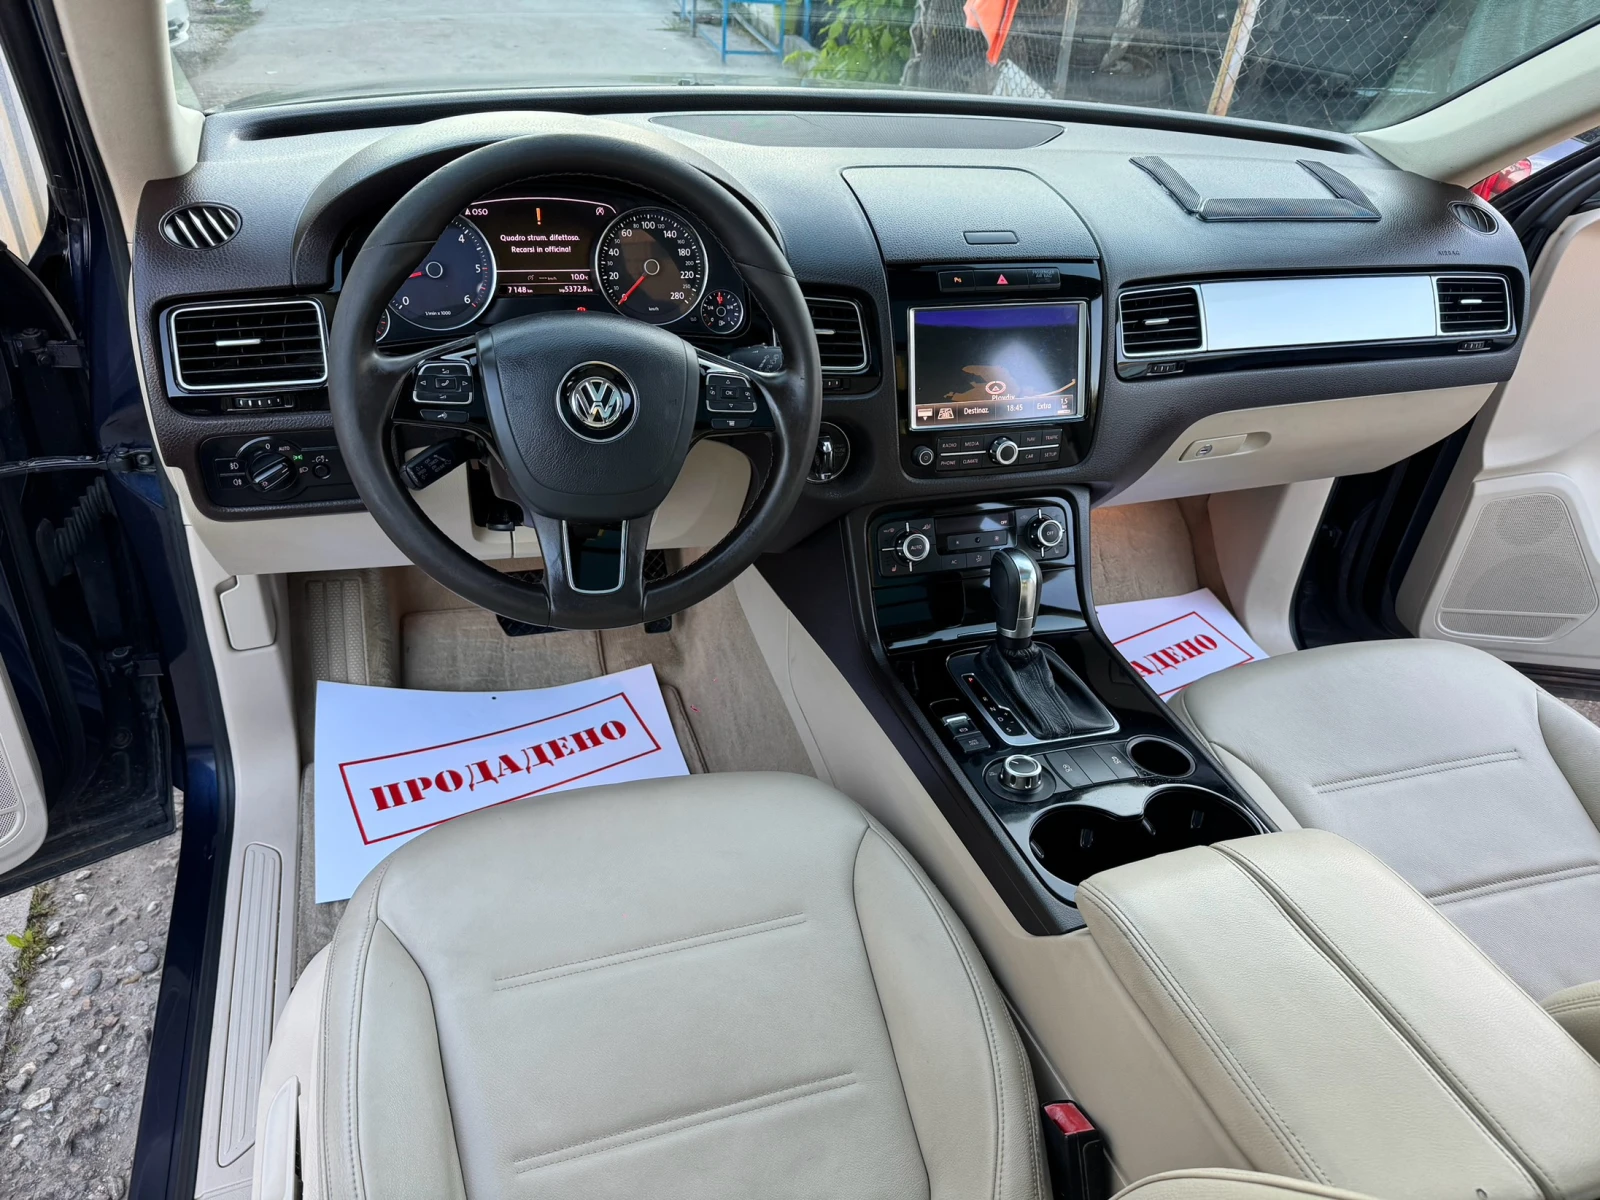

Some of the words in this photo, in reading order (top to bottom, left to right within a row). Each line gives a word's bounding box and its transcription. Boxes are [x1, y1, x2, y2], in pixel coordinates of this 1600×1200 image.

[641, 221, 655, 229] 100
[621, 229, 632, 237] 60
[663, 230, 677, 238] 140
[458, 234, 465, 243] 4
[500, 234, 526, 242] Quadro
[475, 264, 481, 273] 5
[609, 271, 619, 279] 20
[680, 271, 694, 279] 220
[464, 294, 471, 304] 6
[670, 291, 685, 299] 280
[402, 296, 410, 306] 0
[1006, 404, 1023, 412] 18:45
[1036, 402, 1052, 410] Extra
[369, 720, 627, 812] ПРОДАДЕНО
